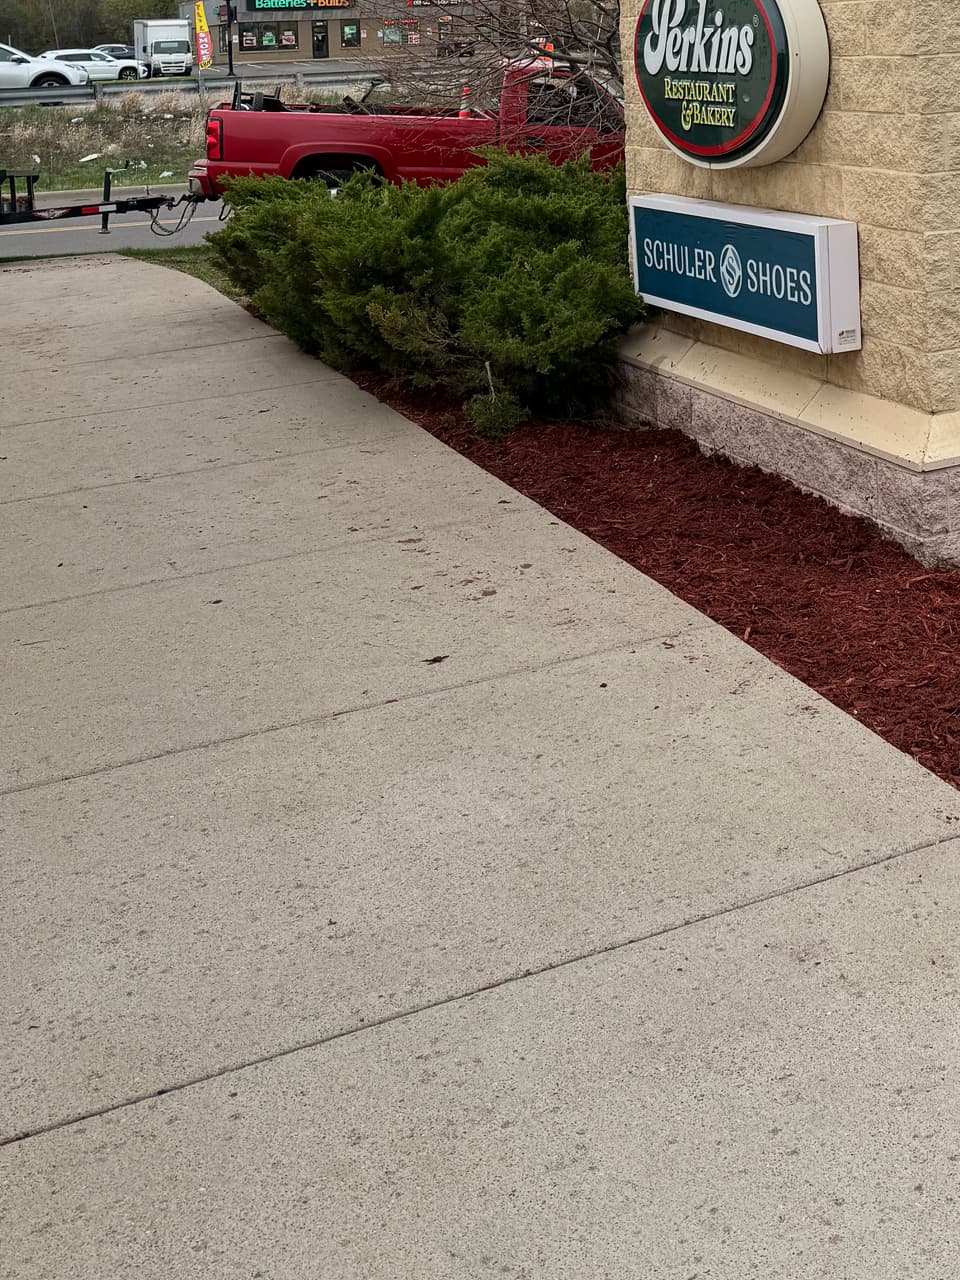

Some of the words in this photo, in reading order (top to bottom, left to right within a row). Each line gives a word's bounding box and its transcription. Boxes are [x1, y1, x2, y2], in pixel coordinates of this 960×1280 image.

[664, 77, 736, 102] RESTAURANT
[643, 237, 717, 283] SCHULER
[746, 258, 812, 306] SHOES
